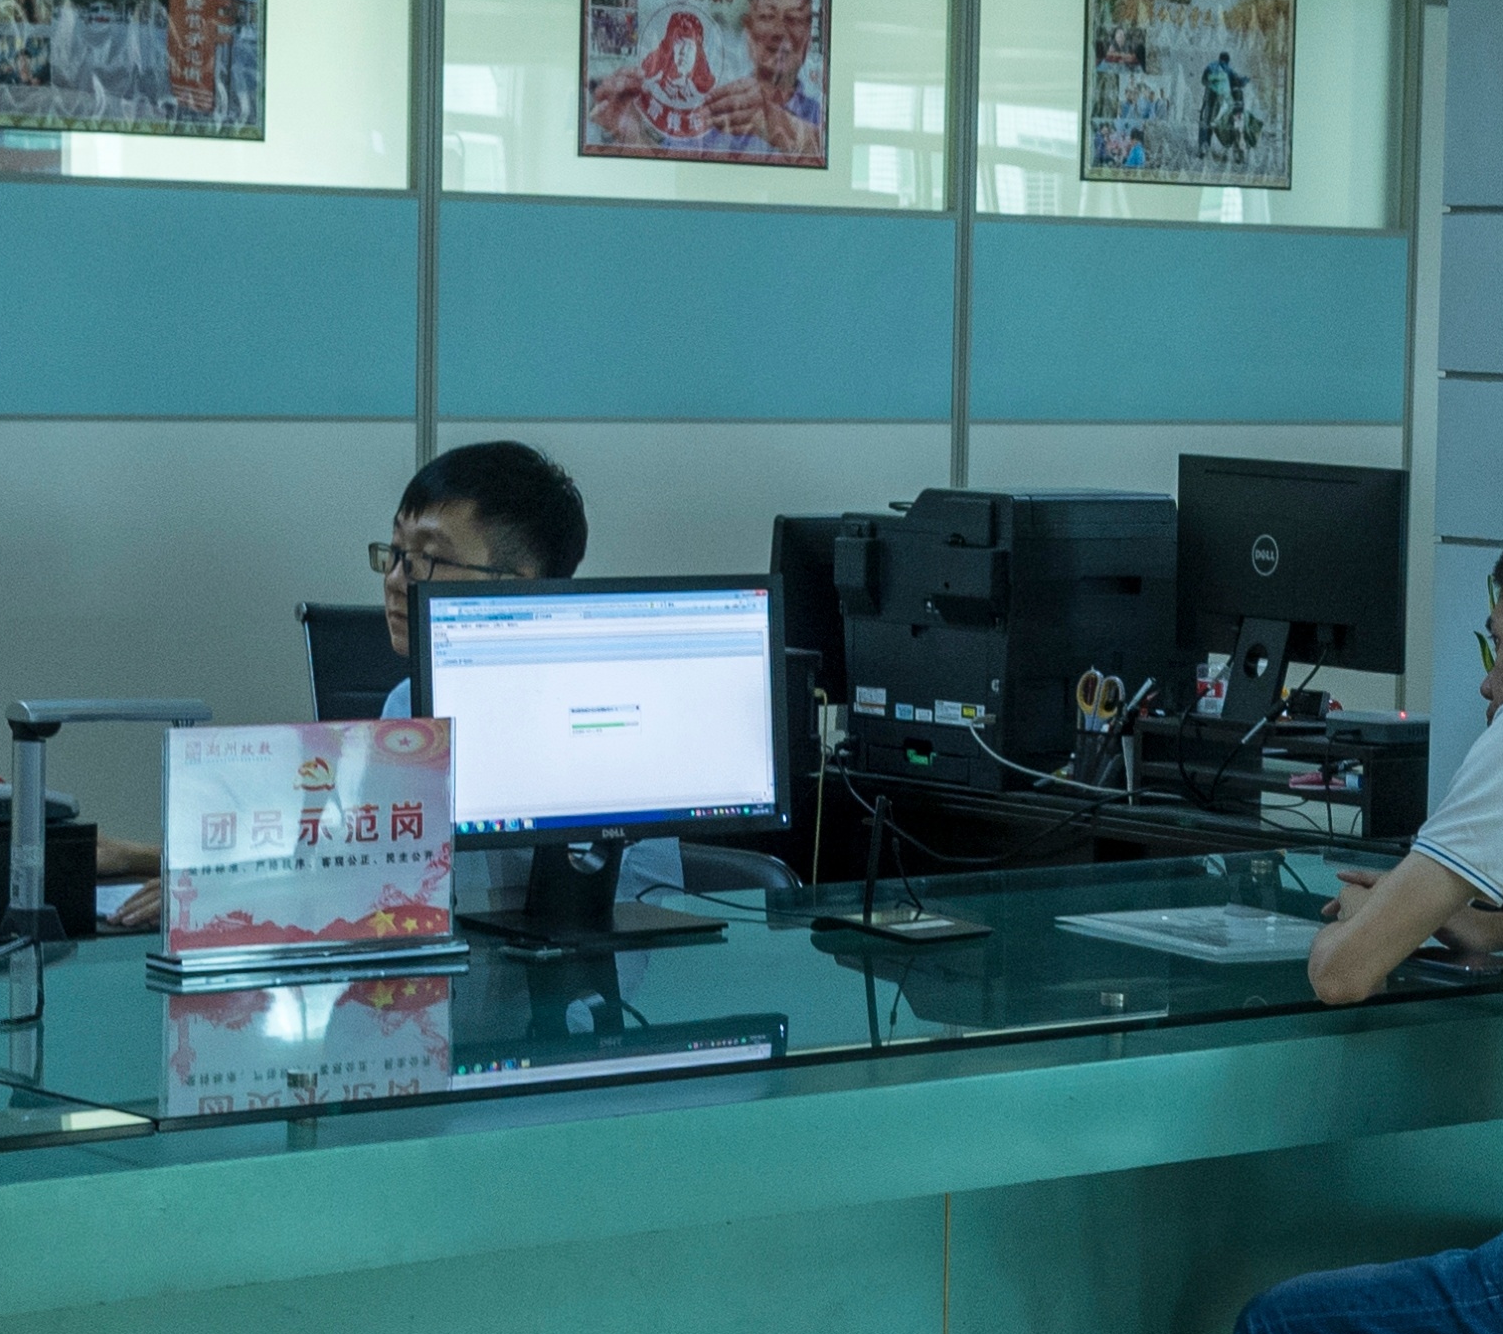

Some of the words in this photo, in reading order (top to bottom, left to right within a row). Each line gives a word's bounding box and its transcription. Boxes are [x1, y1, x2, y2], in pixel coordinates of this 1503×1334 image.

[201, 800, 424, 851] 团员示范岗
